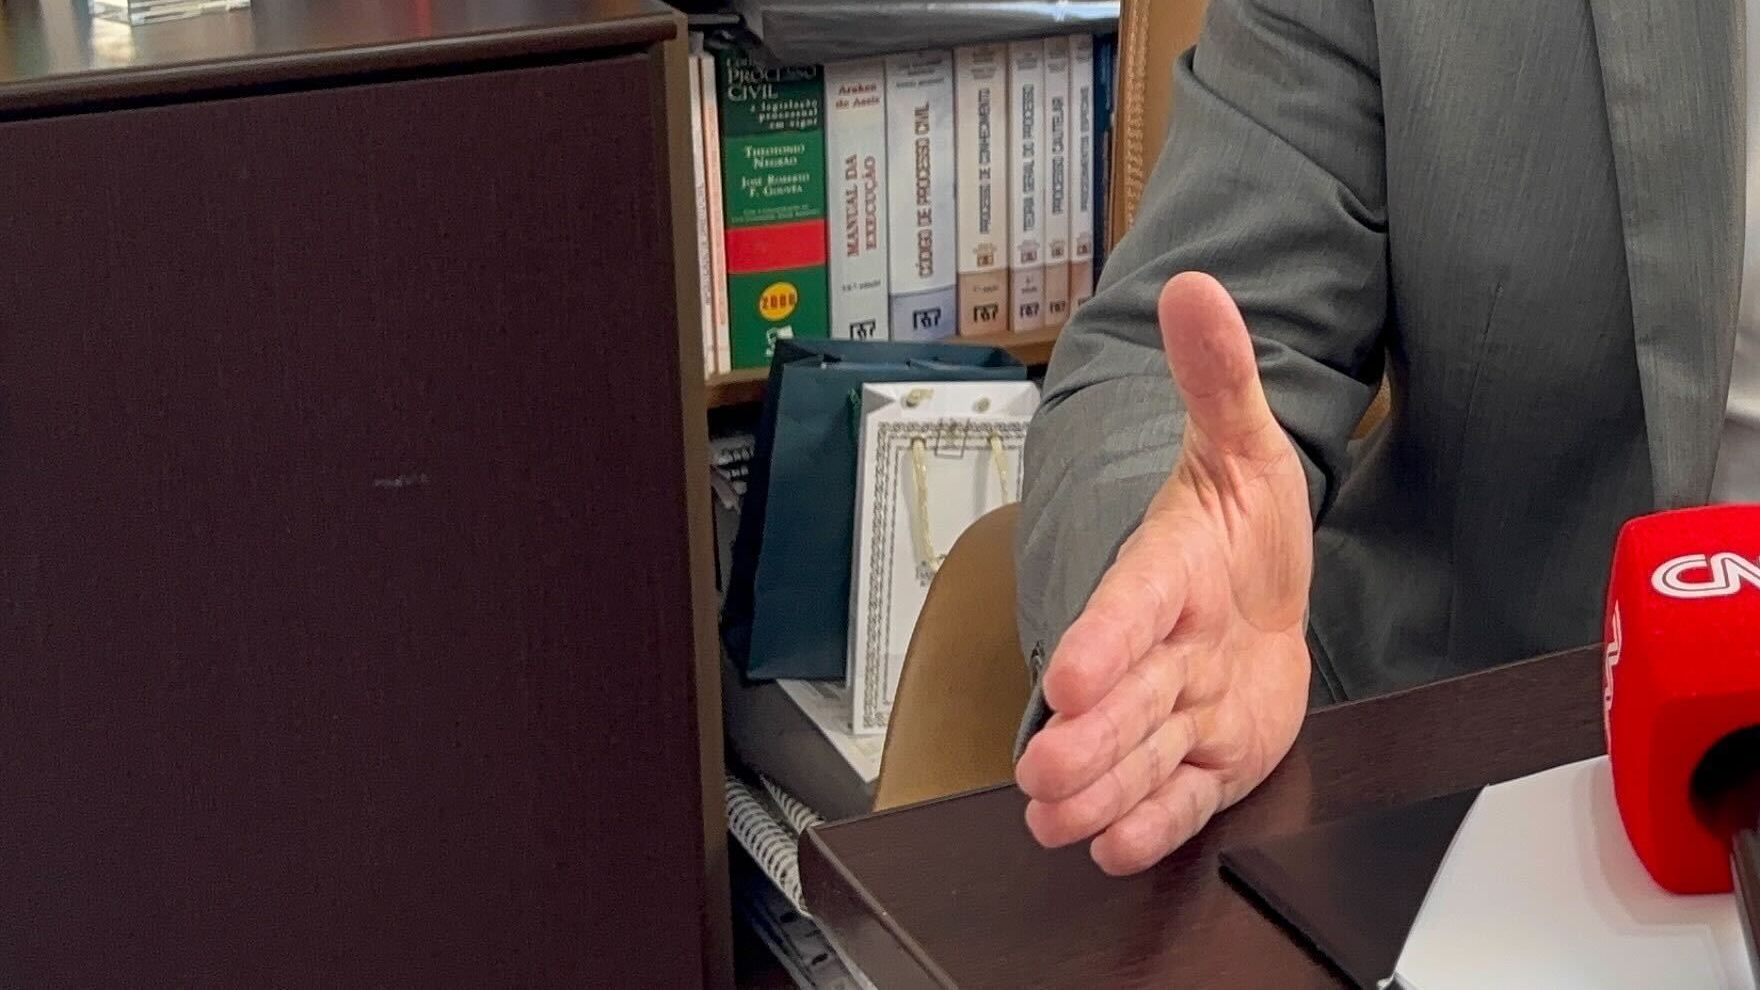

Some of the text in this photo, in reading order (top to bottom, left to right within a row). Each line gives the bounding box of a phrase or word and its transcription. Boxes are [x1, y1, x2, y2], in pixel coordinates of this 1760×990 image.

[727, 84, 778, 102] CIVIL
[844, 153, 860, 258] MANUAL DA
[862, 155, 877, 251] EXECUÇÃO
[914, 102, 934, 278] CÓDIGO DE PROCESSO CIVIL
